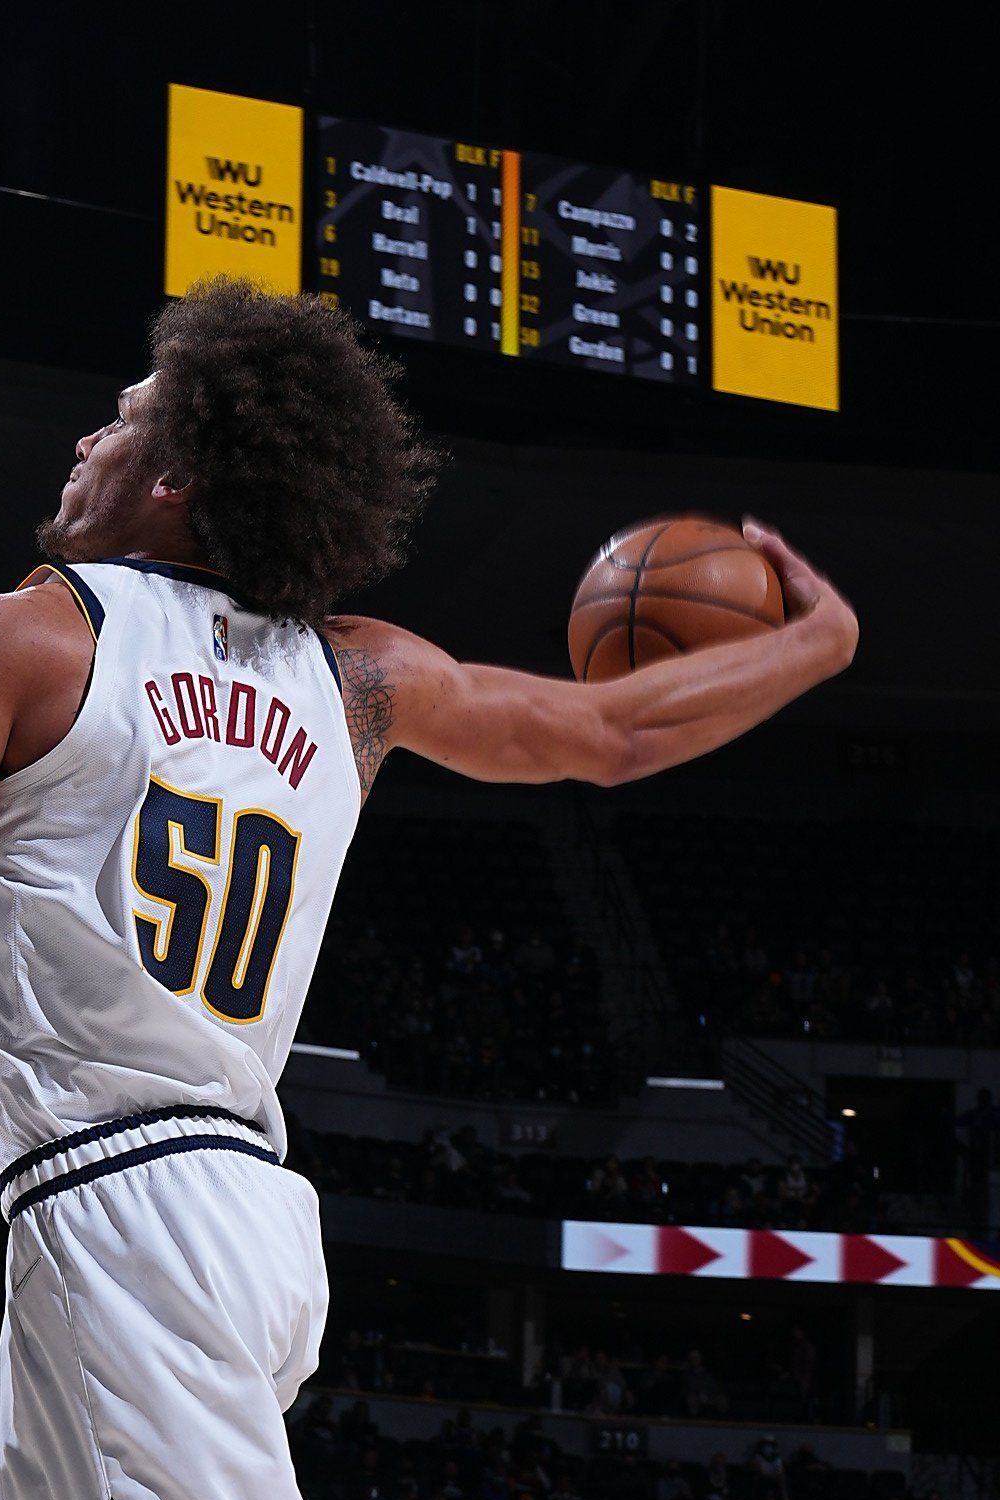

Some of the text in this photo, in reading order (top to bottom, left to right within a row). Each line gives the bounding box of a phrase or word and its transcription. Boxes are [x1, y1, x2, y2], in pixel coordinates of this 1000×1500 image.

[175, 180, 294, 224] Western
[196, 211, 277, 247] Union
[719, 279, 831, 321] Western
[738, 308, 815, 345] Union
[145, 672, 318, 790] GORDON
[132, 775, 302, 1025] 50
